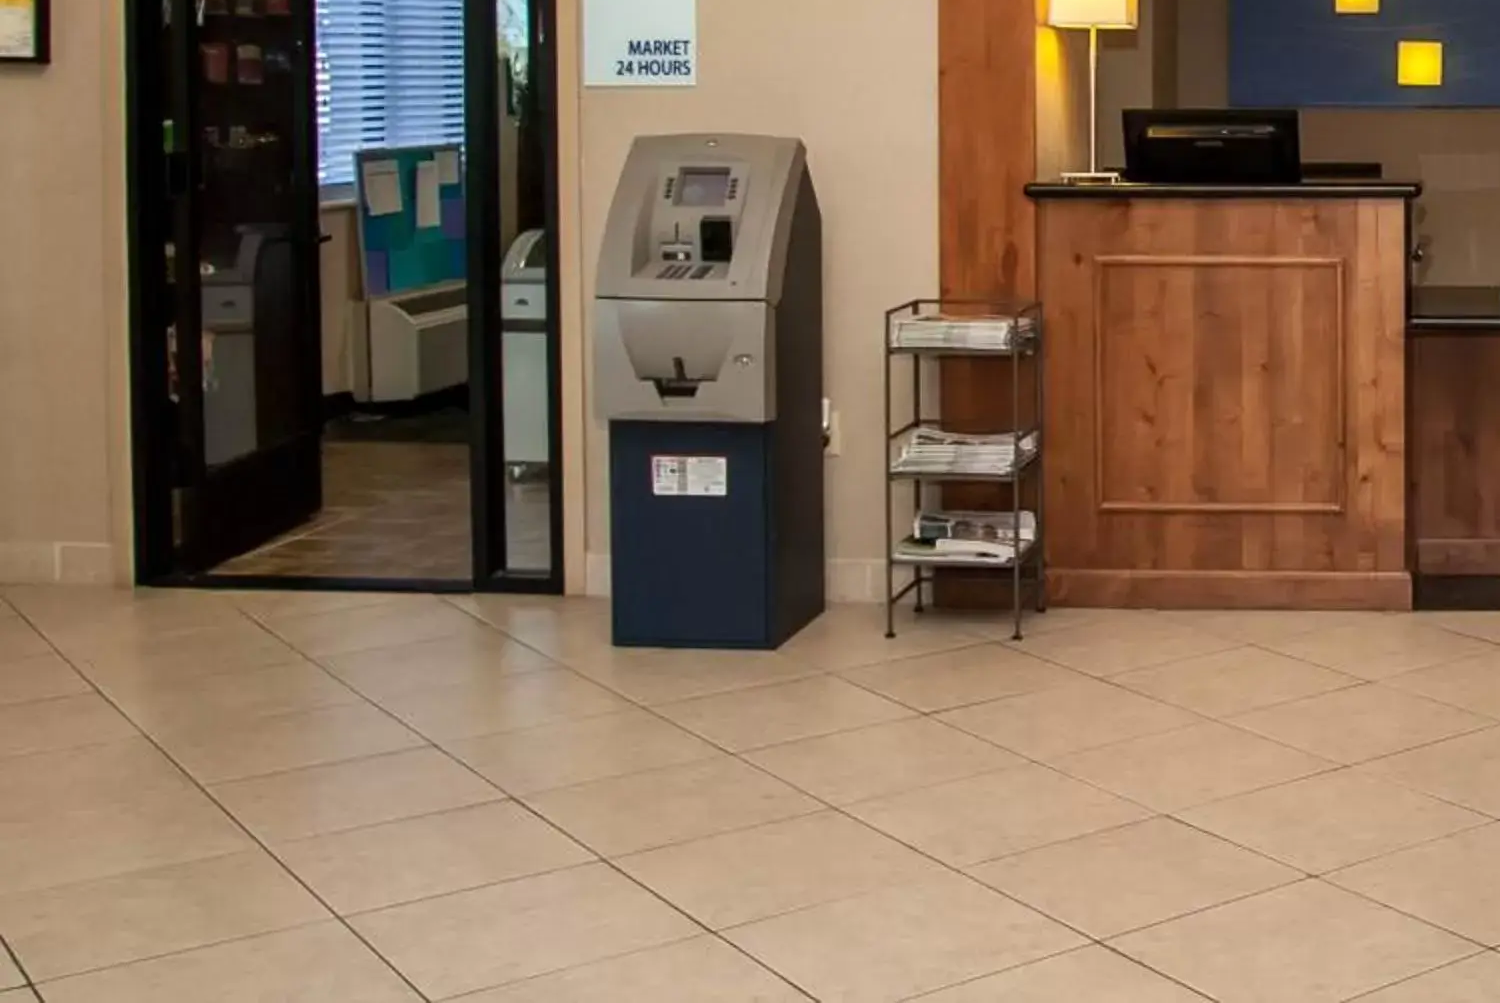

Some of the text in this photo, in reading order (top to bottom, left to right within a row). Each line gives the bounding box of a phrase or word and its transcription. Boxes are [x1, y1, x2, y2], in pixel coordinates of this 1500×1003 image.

[627, 39, 691, 56] MARKET
[615, 59, 692, 77] 24 HOURS
